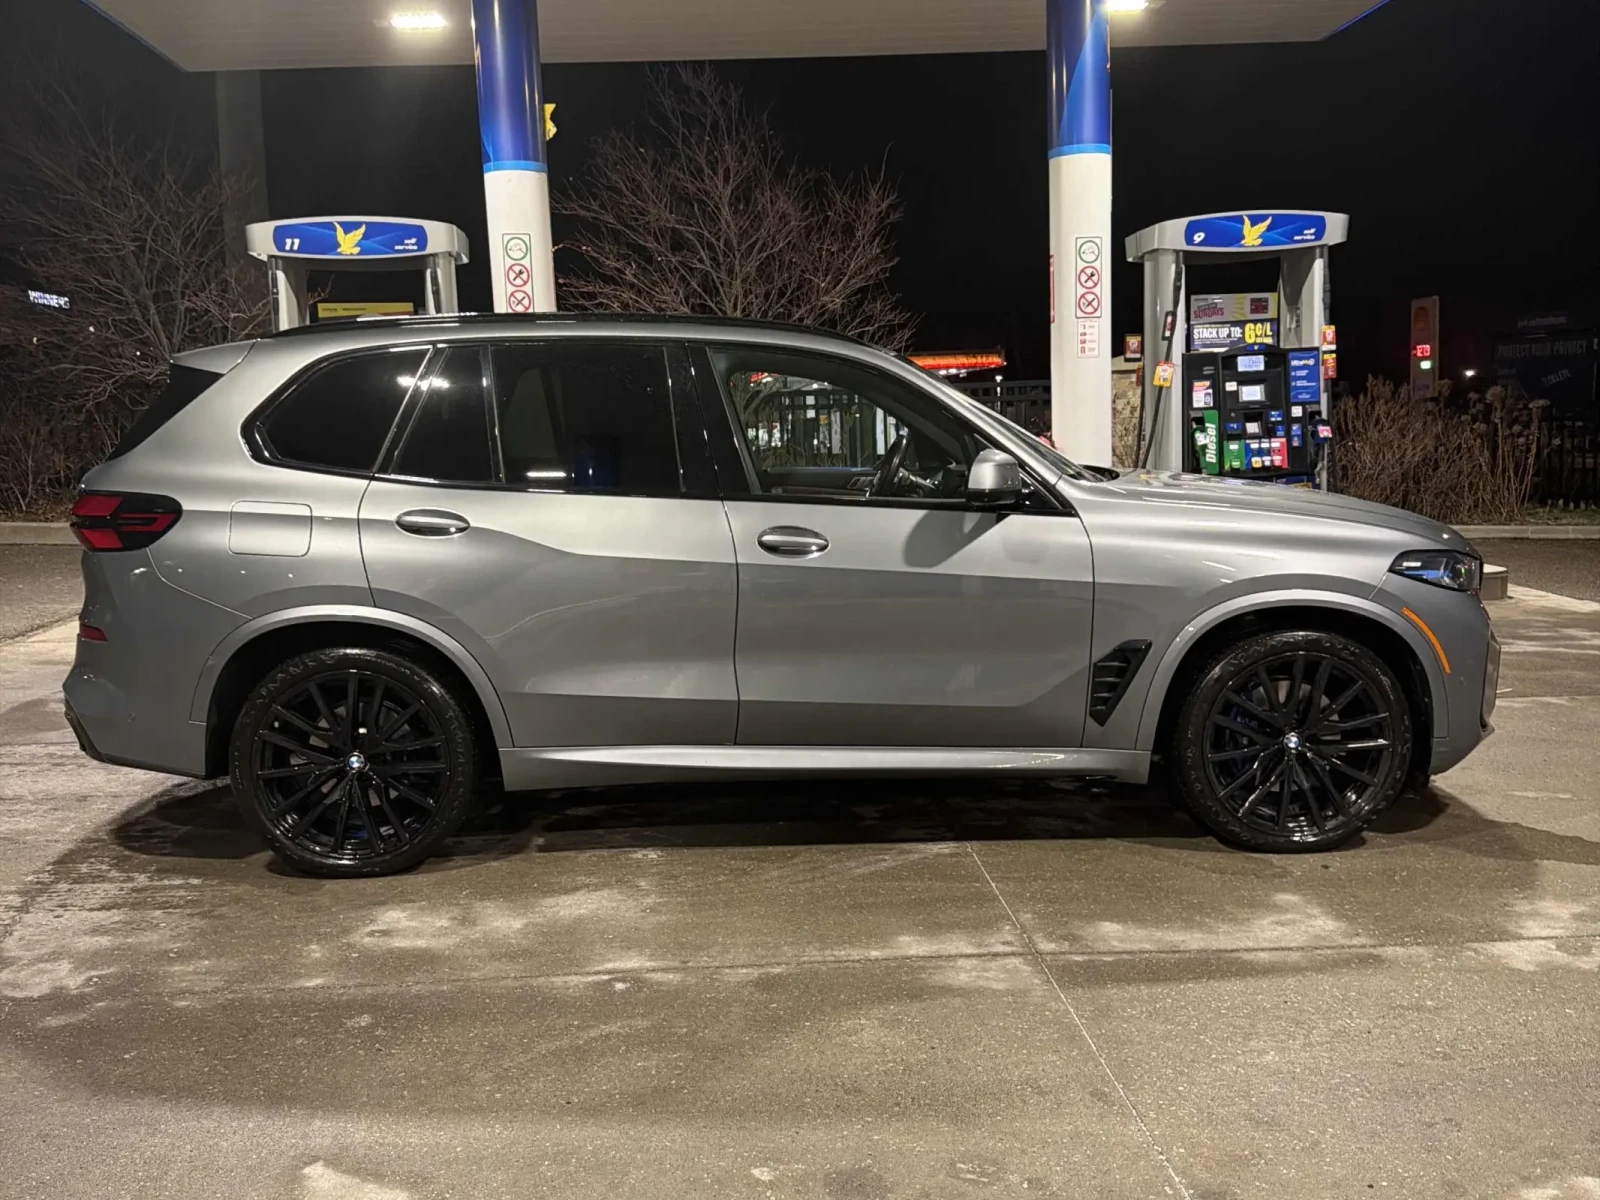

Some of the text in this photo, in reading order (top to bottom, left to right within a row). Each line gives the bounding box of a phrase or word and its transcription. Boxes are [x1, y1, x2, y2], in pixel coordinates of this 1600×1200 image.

[284, 238, 300, 251] 11
[1193, 232, 1206, 244] 9
[1193, 307, 1225, 319] SUNDAYS
[1193, 327, 1218, 340] STACK
[1218, 327, 1230, 339] UP
[1230, 326, 1243, 338] TO:
[1553, 339, 1588, 355] PRIVACY
[1205, 423, 1217, 463] Diesel
